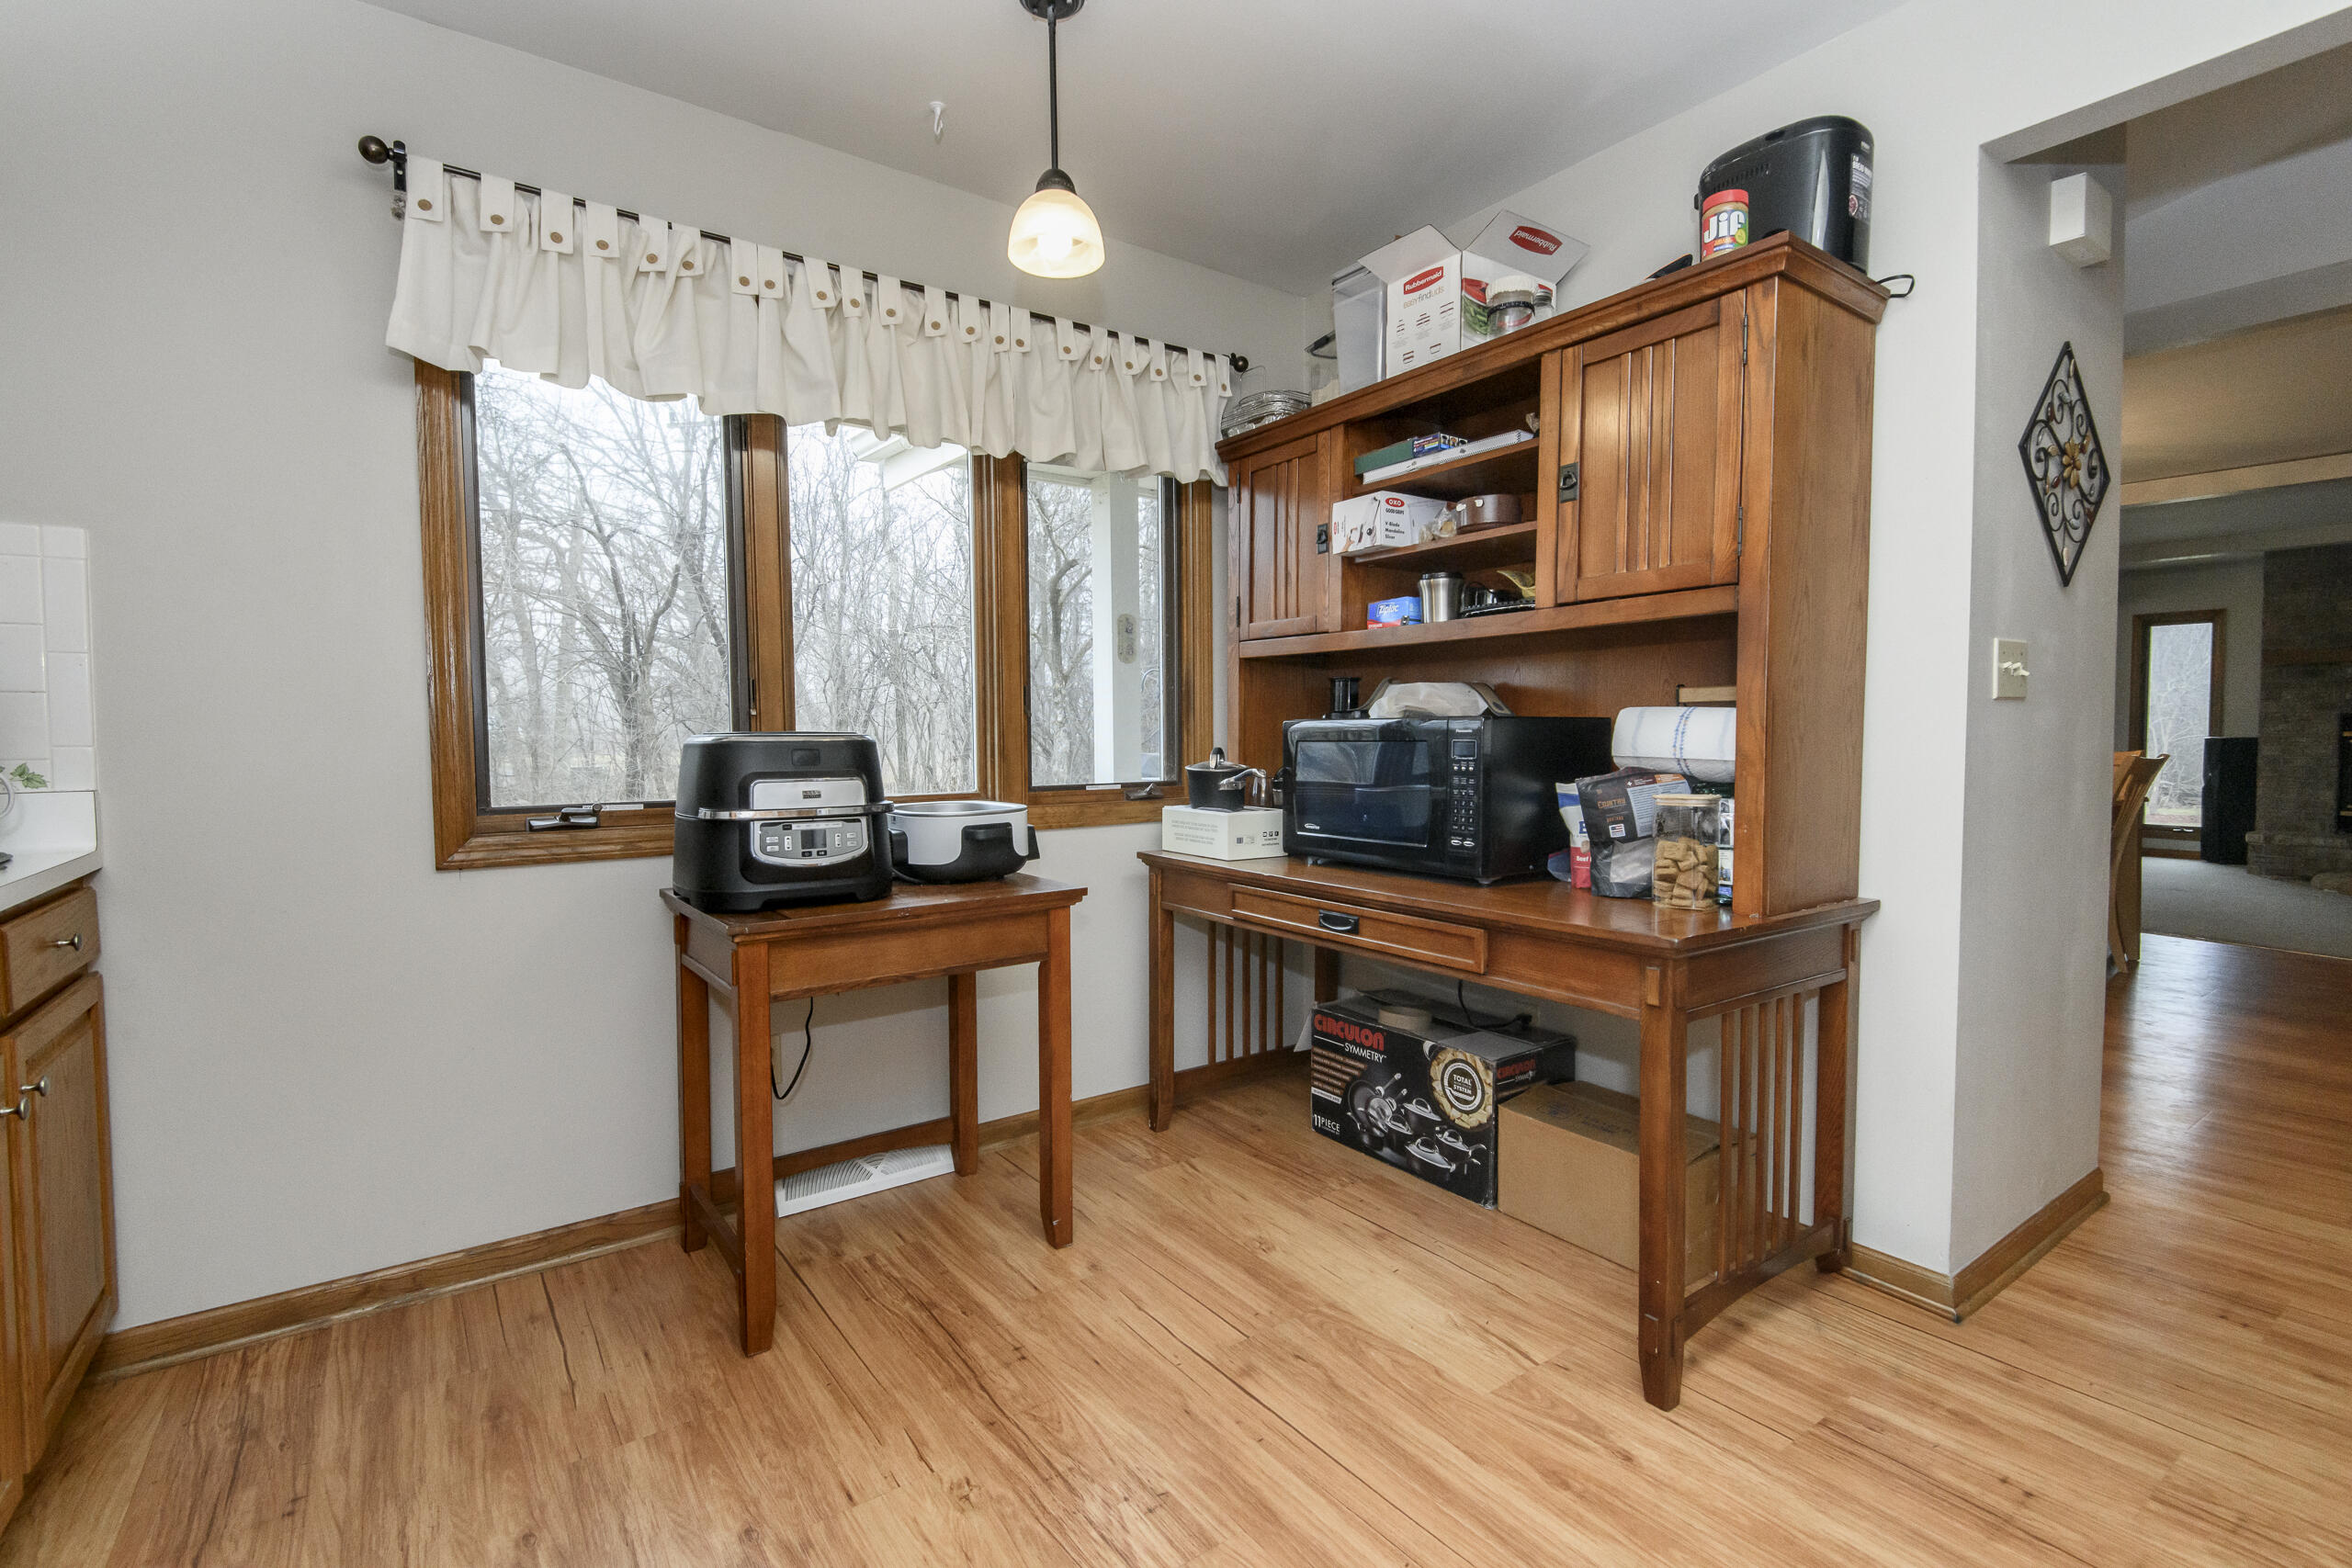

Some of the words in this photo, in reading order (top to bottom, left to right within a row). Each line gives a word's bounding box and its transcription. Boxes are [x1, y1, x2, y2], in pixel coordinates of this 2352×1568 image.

[1703, 210, 1746, 244] Jif
[1514, 230, 1557, 252] Rubbermaid
[1405, 270, 1442, 292] Rubbermaid
[1388, 499, 1402, 507] OXO
[1379, 603, 1399, 616] Ziploc
[1314, 1013, 1385, 1052] CIRCULON
[1453, 1074, 1472, 1086] TOTAL
[1453, 1085, 1472, 1095] SYSTEM
[1314, 1113, 1321, 1128] 11
[1320, 1117, 1340, 1133] PIECE
